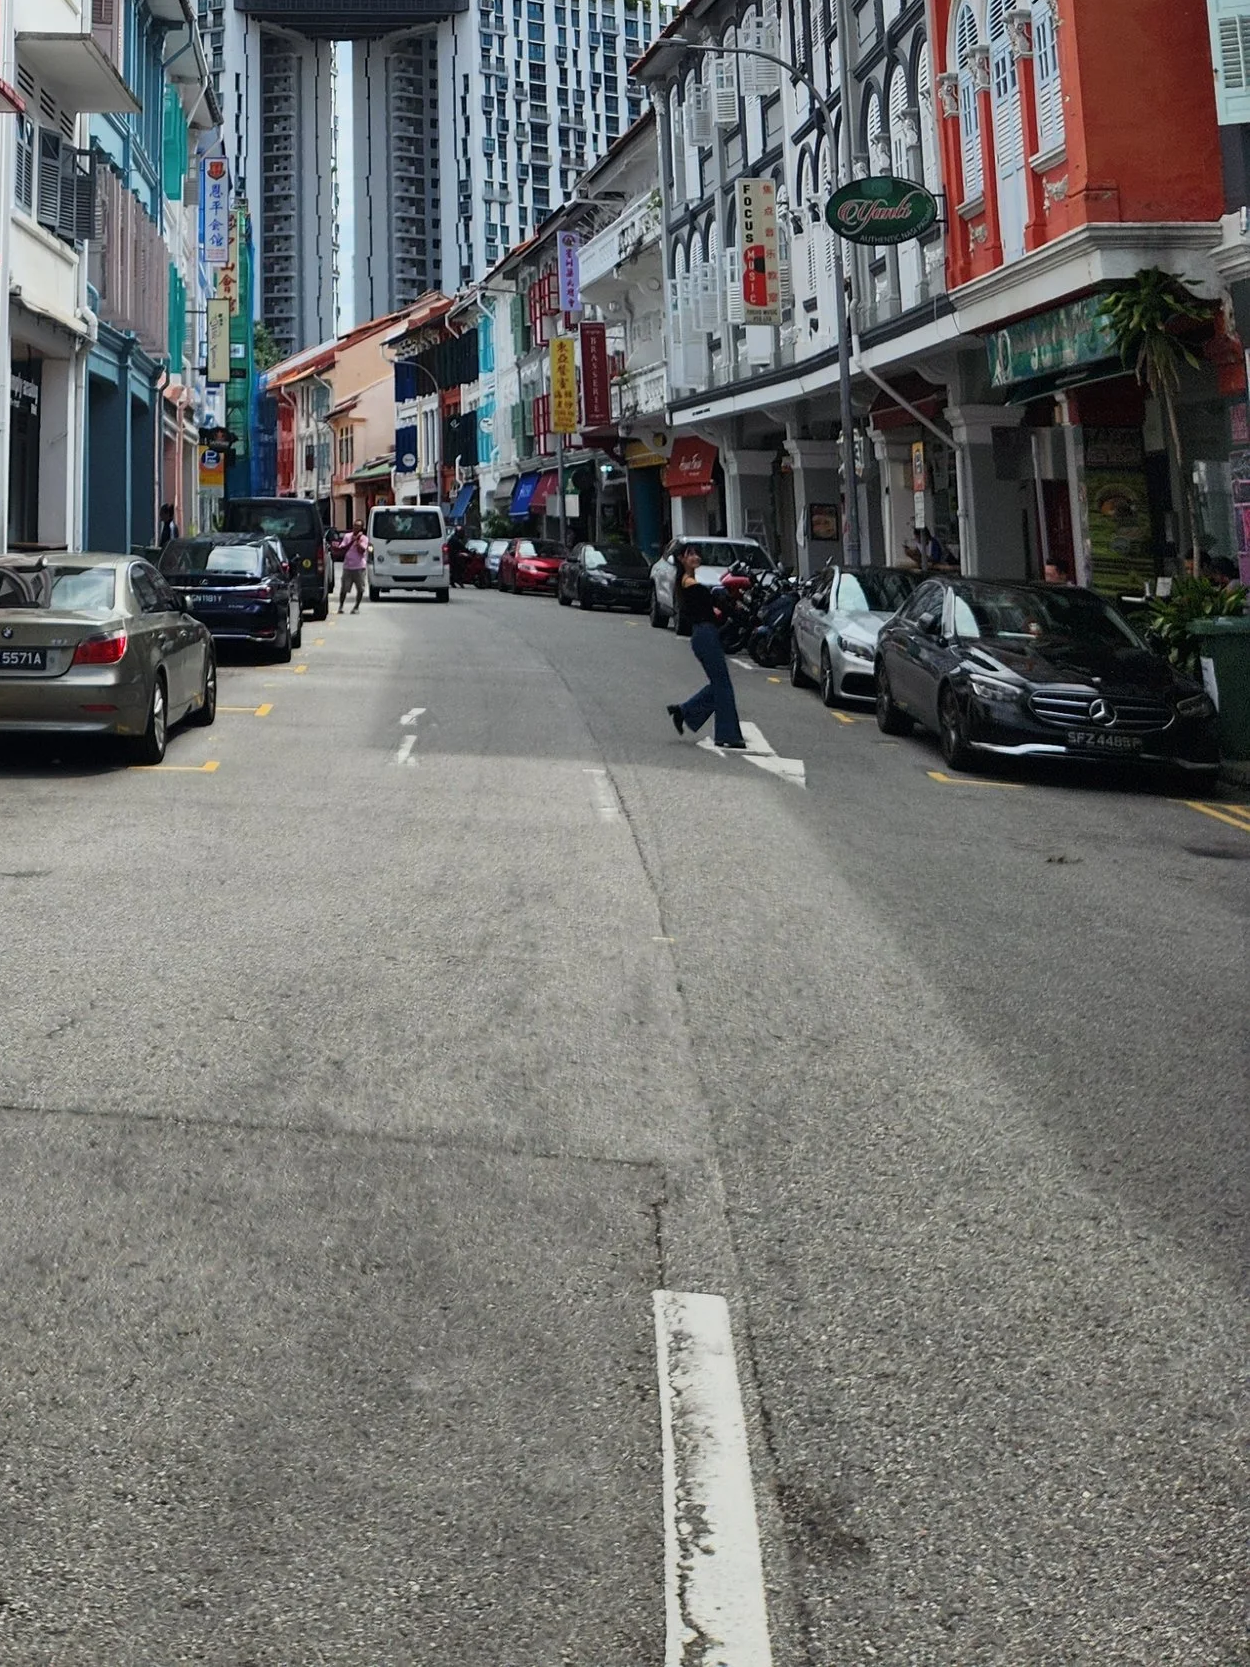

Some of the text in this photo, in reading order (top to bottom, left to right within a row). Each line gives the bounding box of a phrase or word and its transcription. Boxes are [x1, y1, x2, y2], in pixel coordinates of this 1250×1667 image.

[743, 184, 753, 243] FOCUS
[746, 250, 757, 304] MUSIC
[590, 337, 601, 413] BRASSERIE
[191, 595, 222, 603] GN1181Y
